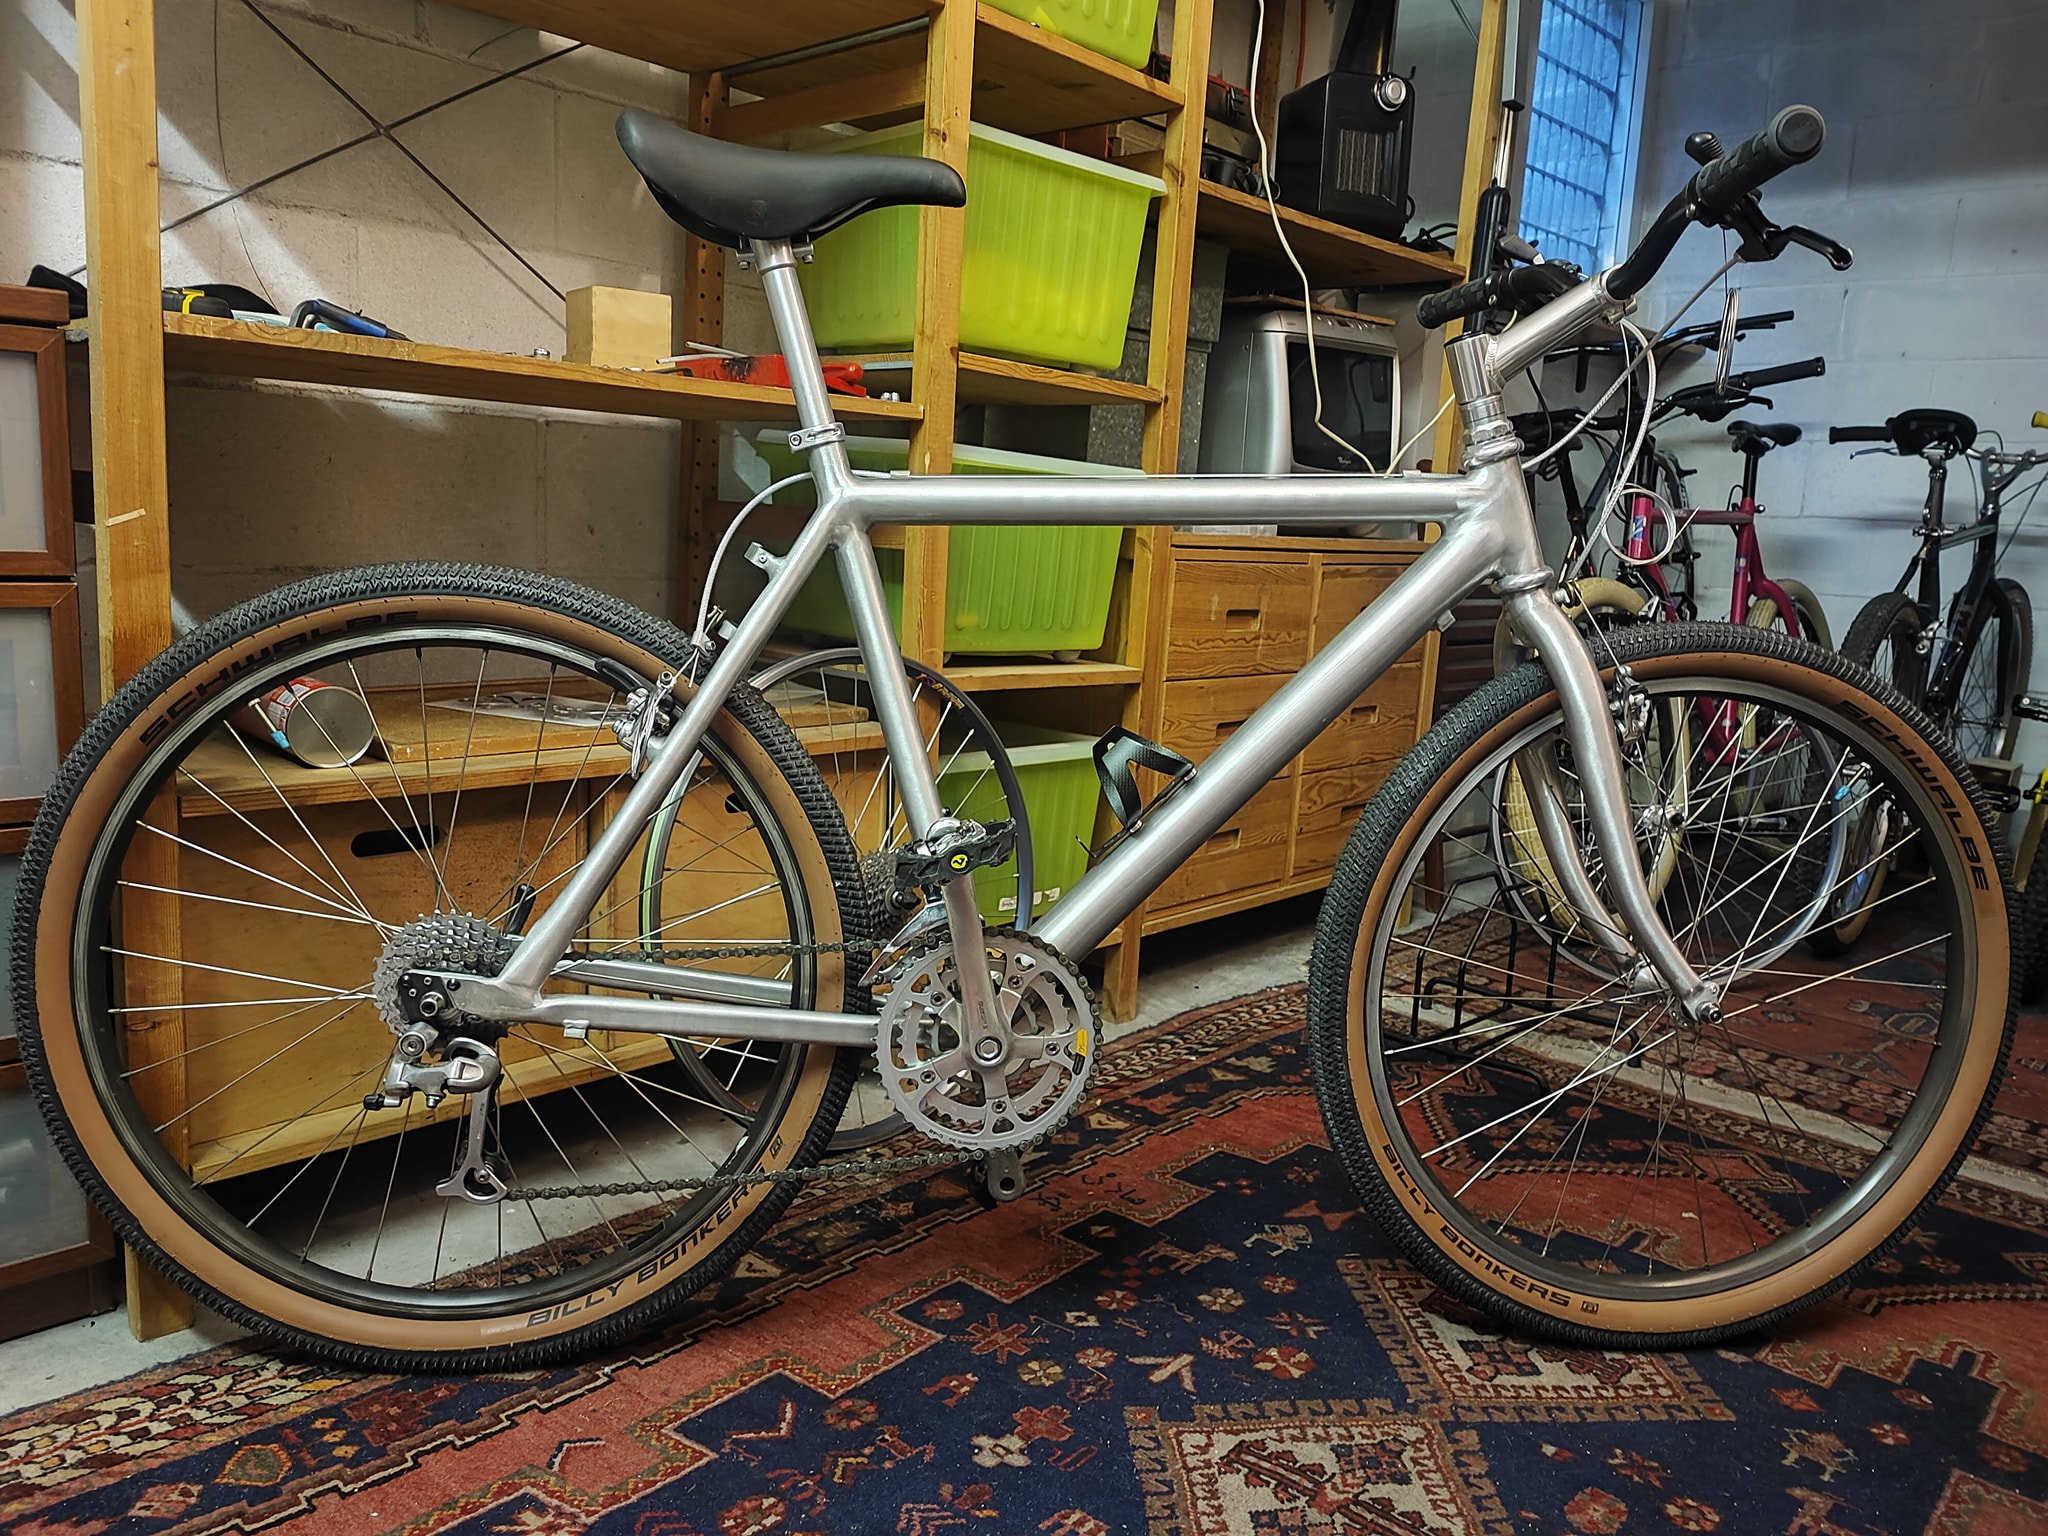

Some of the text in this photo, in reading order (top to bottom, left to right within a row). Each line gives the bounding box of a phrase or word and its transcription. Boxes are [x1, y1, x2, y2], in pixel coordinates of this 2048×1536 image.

[139, 611, 418, 745] SCHWALBE
[1840, 701, 1989, 891] SCHWALBE
[1383, 1145, 1571, 1307] BILLY BONKERS
[527, 1280, 625, 1328] BILLY
